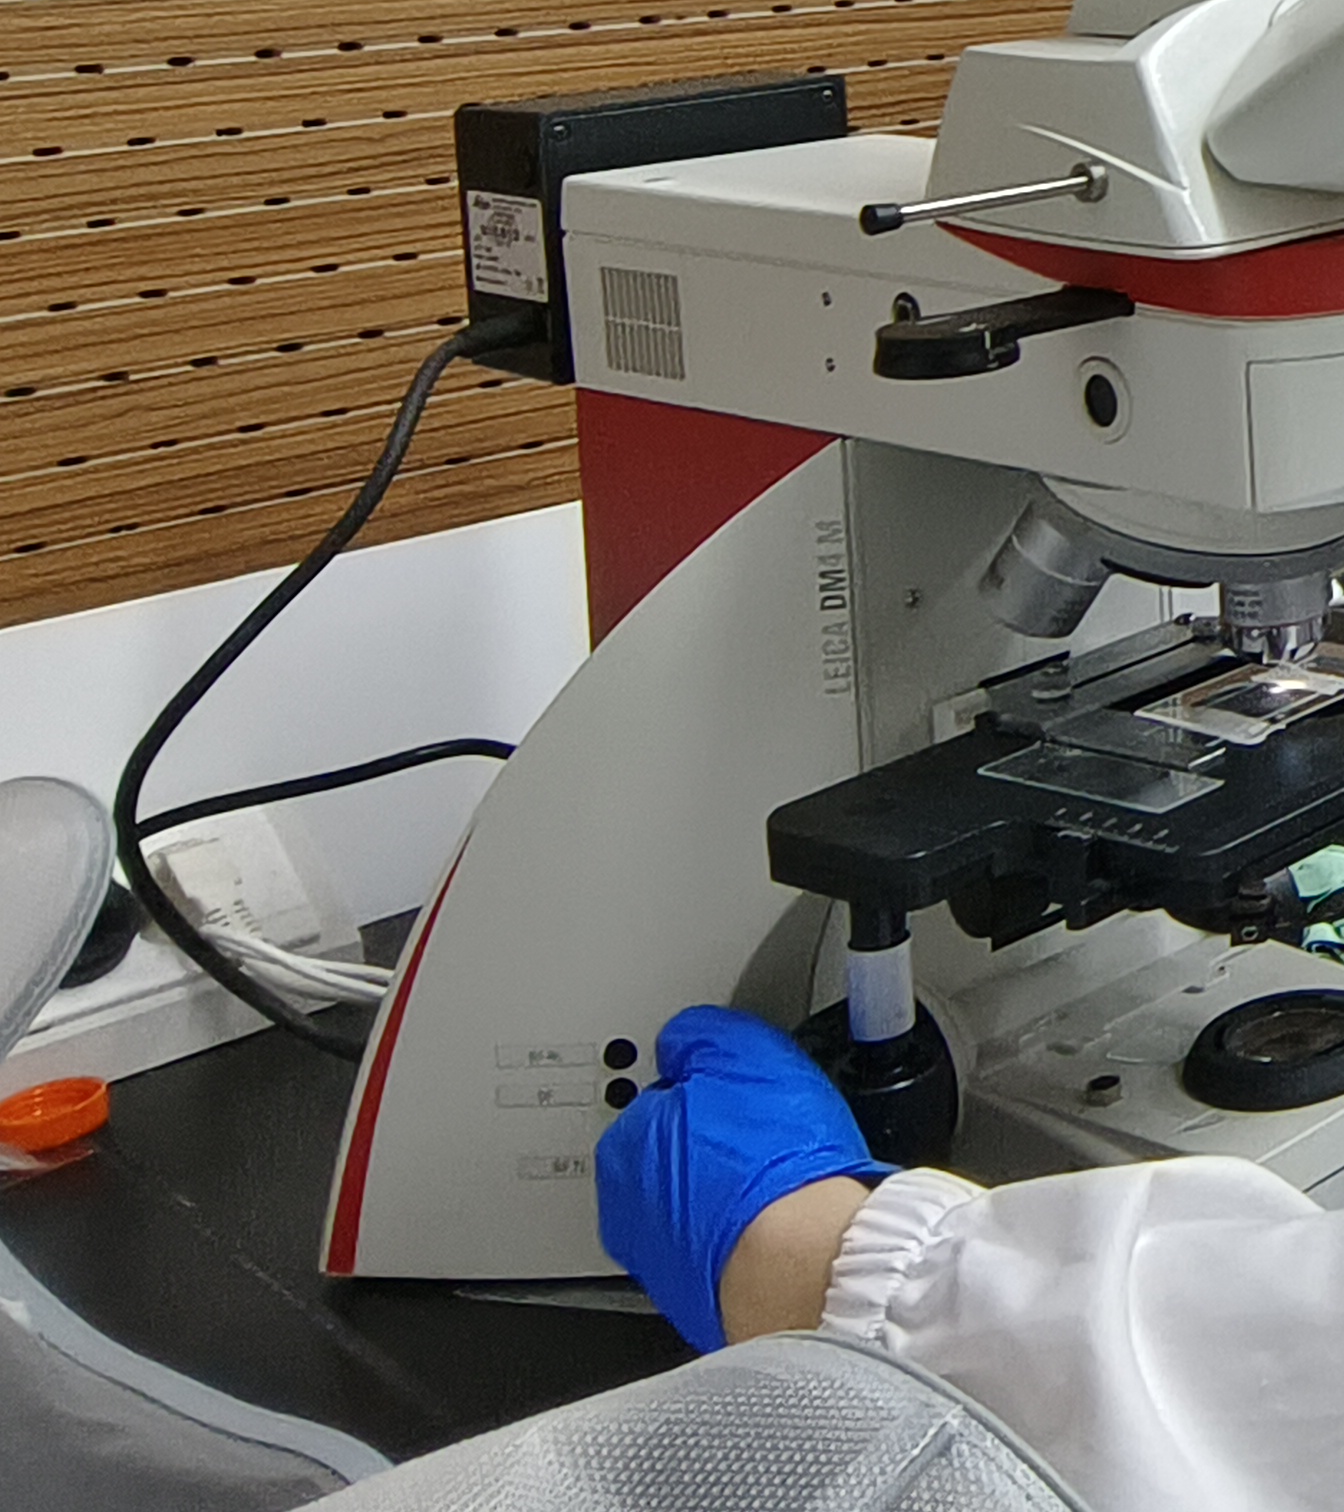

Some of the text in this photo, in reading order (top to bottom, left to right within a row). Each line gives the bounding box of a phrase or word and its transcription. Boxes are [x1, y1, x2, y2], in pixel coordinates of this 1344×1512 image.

[815, 520, 851, 695] LEICA DM4 M
